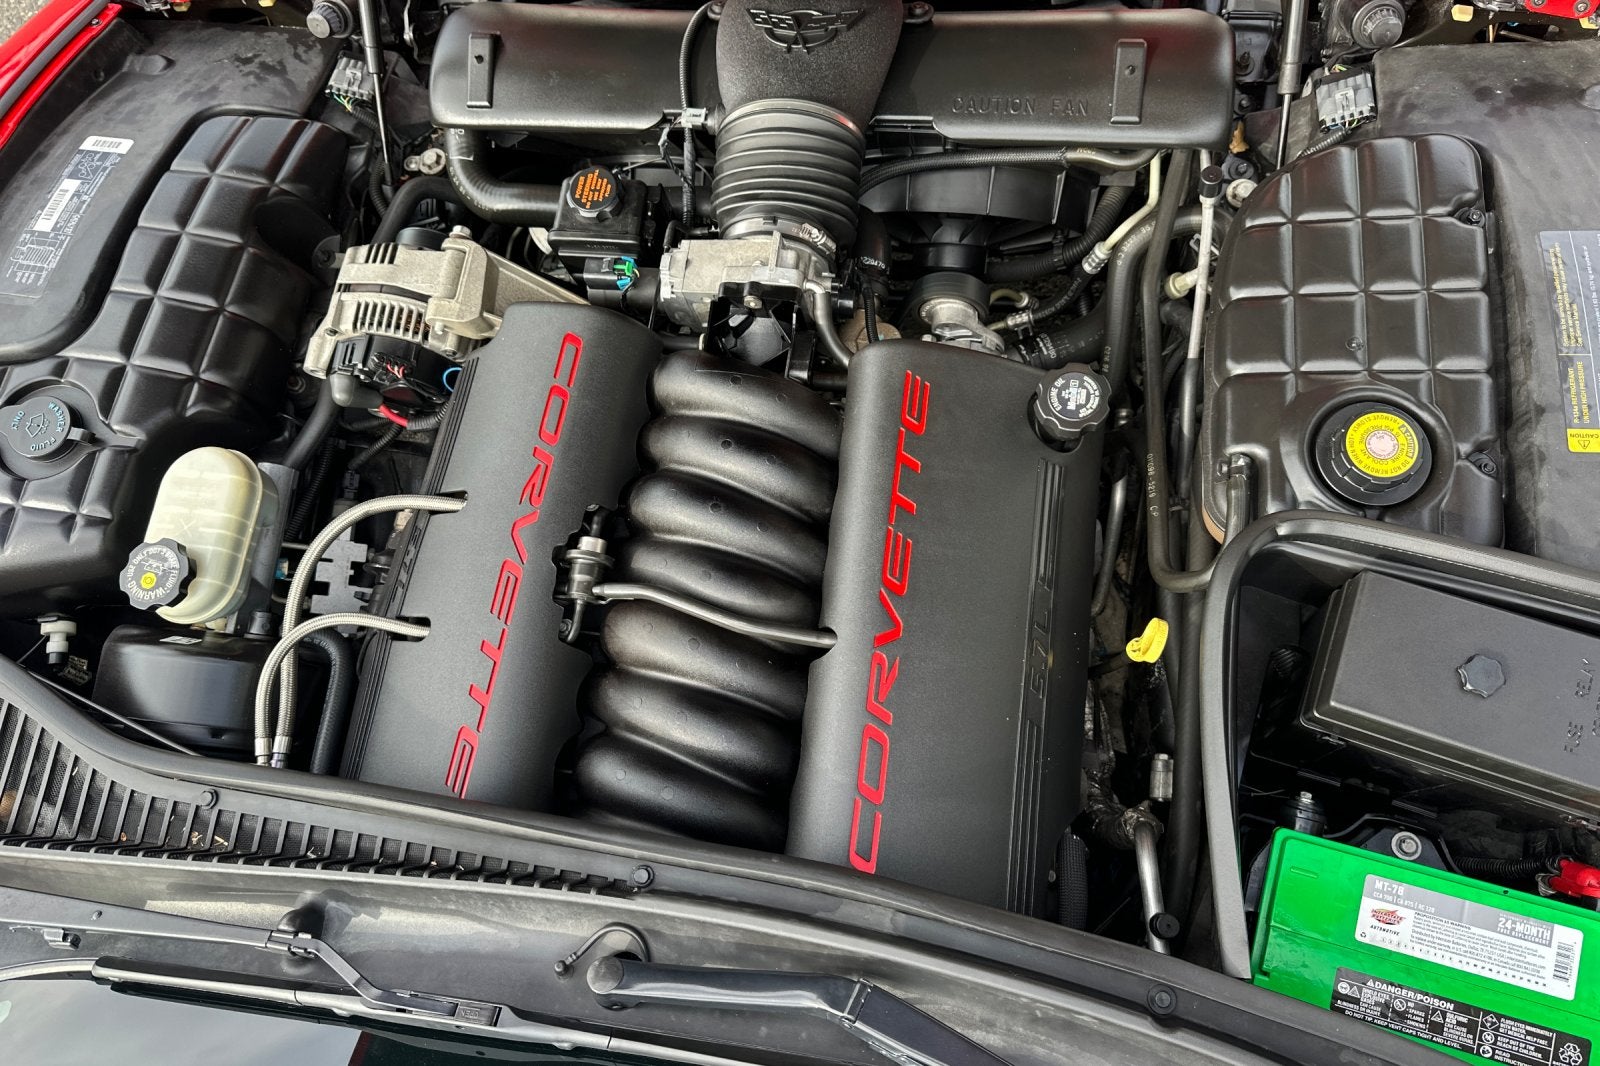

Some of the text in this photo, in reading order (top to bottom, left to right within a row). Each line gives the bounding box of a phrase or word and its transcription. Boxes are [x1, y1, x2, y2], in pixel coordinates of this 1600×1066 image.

[952, 96, 1089, 117] CAUTION FAN
[575, 176, 585, 198] POWER
[582, 173, 593, 202] STEERING
[1577, 362, 1586, 389] PRESSURE
[1050, 378, 1066, 411] ENGINE OIL
[1568, 368, 1578, 406] REFRIGERANT
[1373, 415, 1398, 423] REMOVE
[1582, 404, 1590, 424] UNDER
[11, 402, 65, 452] WASHER FLUID ONLY
[1352, 418, 1370, 432] SLOWLY
[1351, 450, 1363, 465] WHEN
[1361, 449, 1389, 465] COOLANT
[1391, 444, 1405, 463] ENGINE
[1363, 465, 1388, 474] REMOVE
[133, 550, 149, 564] ONLY
[165, 550, 177, 570] BRAKE
[445, 331, 583, 799] CORVETTE
[127, 564, 136, 577] USE
[166, 570, 178, 588] FLUID
[128, 580, 166, 600] WARNING
[849, 370, 930, 875] CORVETTE
[1031, 611, 1048, 699] 5.7L
[1564, 721, 1584, 753] FUSE
[1371, 909, 1404, 921] INTERSTATE
[1370, 925, 1400, 936] AUTOMOTIVE
[1498, 917, 1552, 940] 24-MONTH
[1374, 982, 1454, 1010] DANGER/POISON
[1408, 1014, 1424, 1022] FLAMES
[1374, 1019, 1388, 1027] KEEP
[1388, 1023, 1402, 1031] VENT
[1402, 1027, 1416, 1035] CAPS
[1417, 1032, 1432, 1040] TIGHT
[1444, 1040, 1463, 1050] LEVEL.
[1508, 1031, 1526, 1039] MEDICAL
[1495, 1049, 1510, 1058] READ
[1497, 1041, 1512, 1049] REACH
